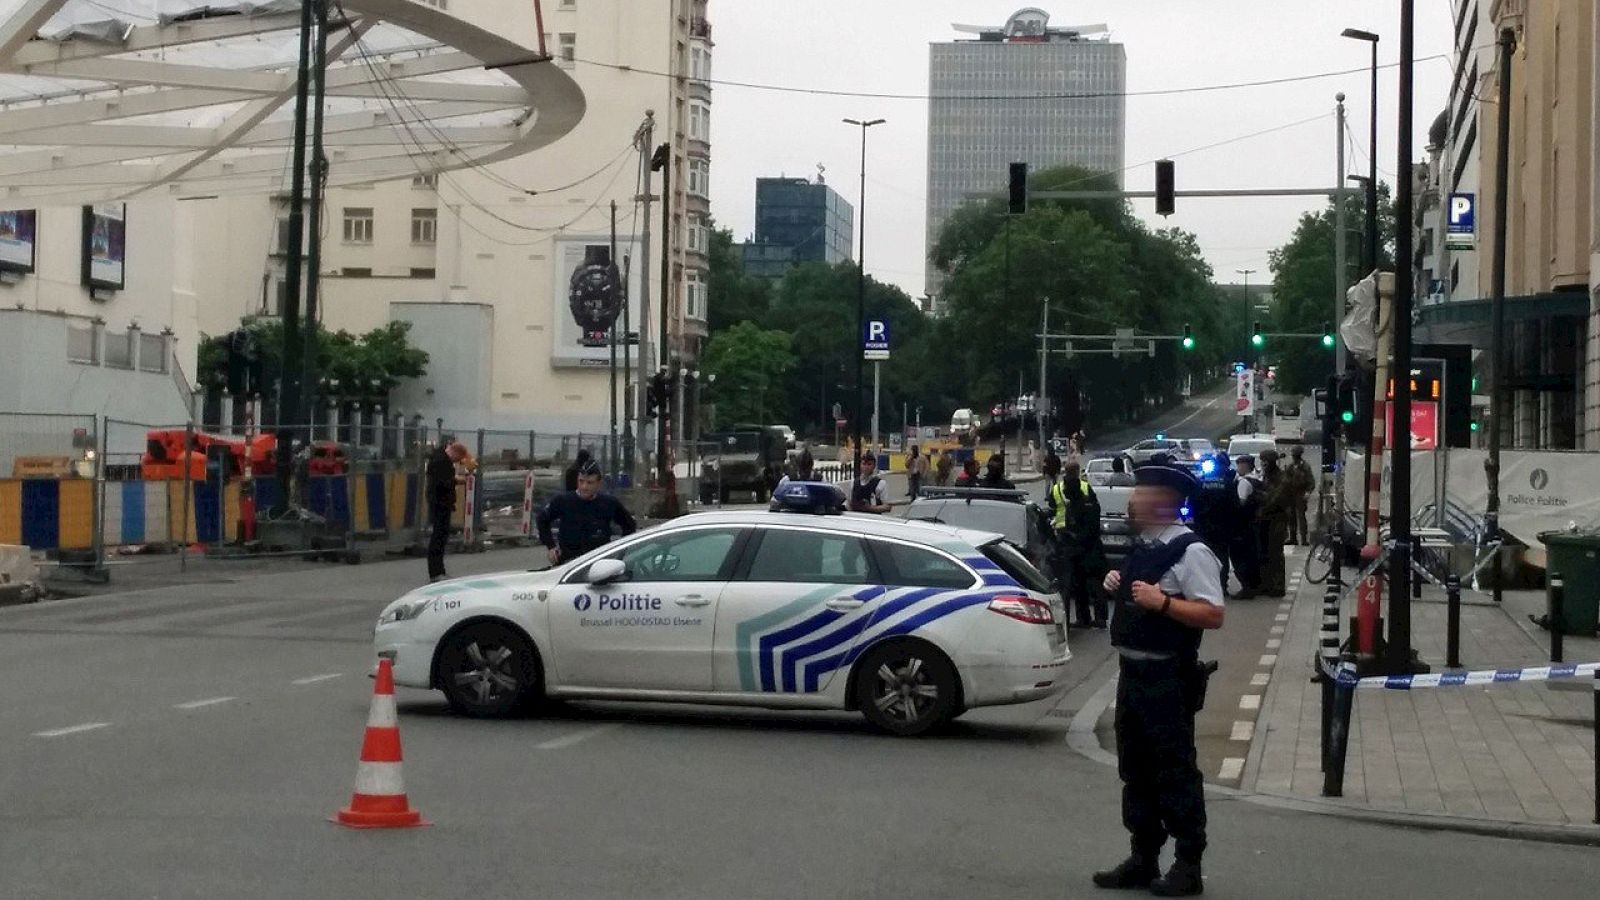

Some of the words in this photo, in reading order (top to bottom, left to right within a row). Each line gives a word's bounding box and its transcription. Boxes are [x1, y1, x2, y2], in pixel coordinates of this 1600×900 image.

[1451, 197, 1471, 223] P
[445, 600, 461, 609] 101
[599, 593, 662, 610] Politie
